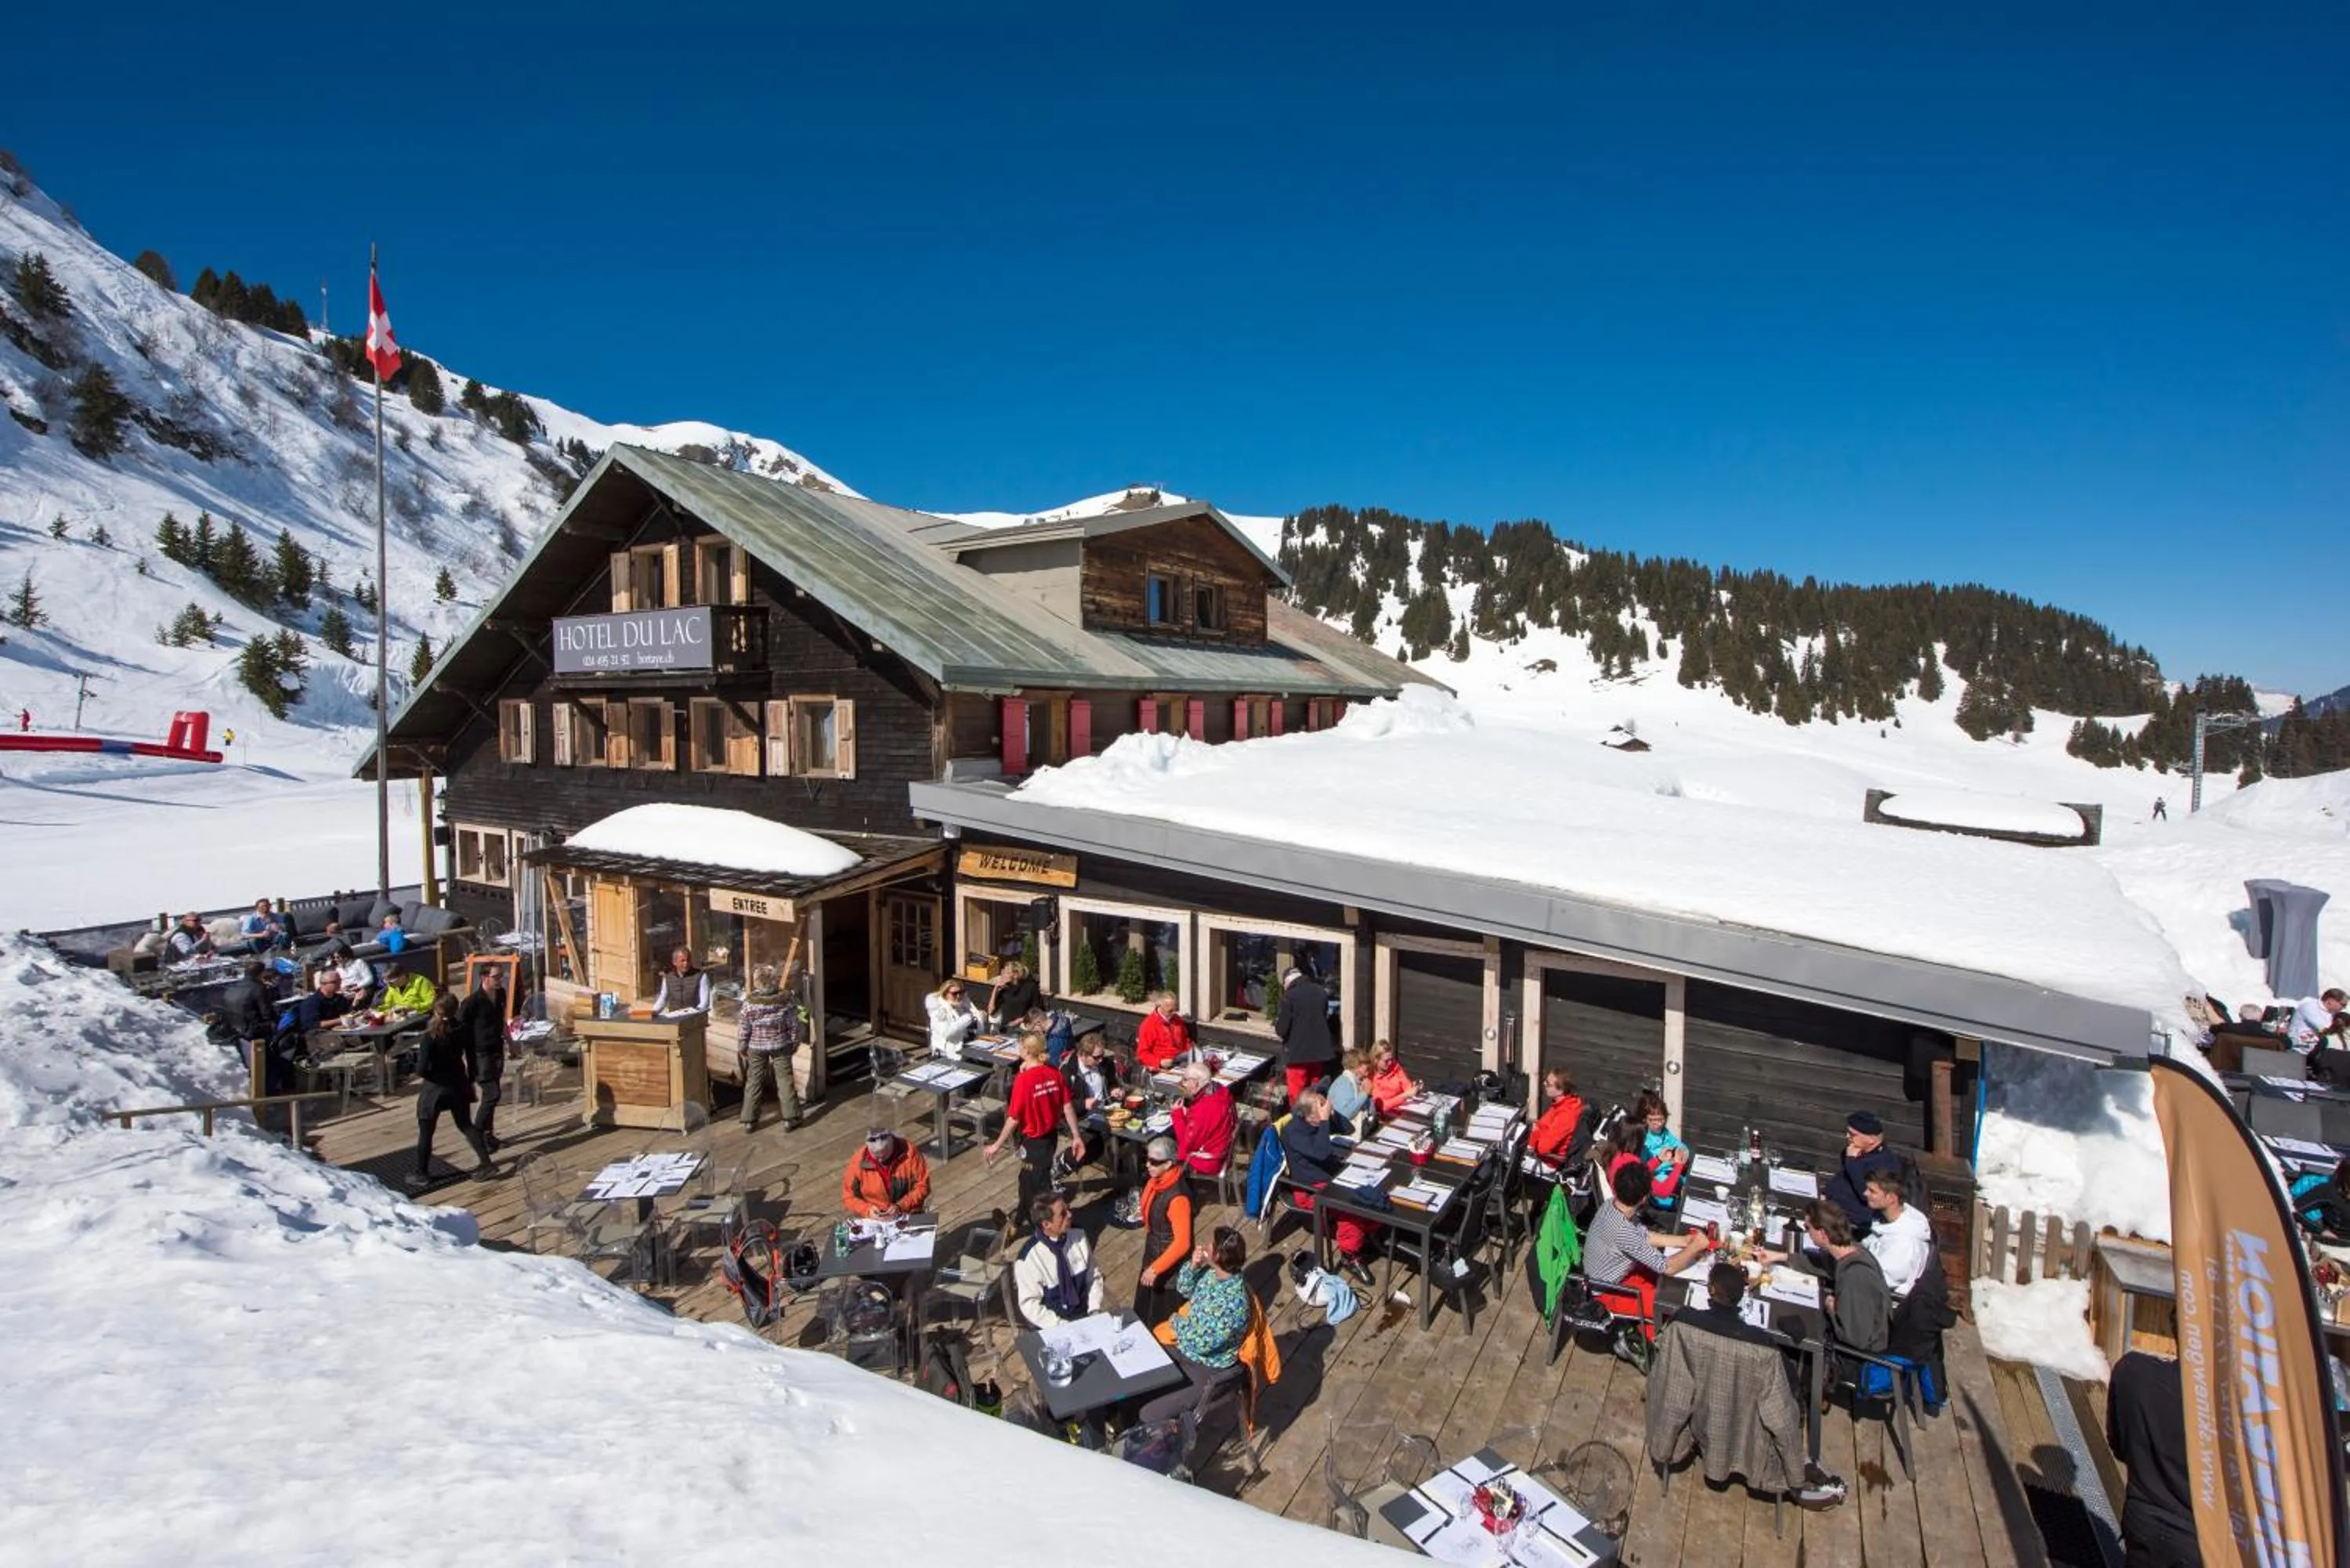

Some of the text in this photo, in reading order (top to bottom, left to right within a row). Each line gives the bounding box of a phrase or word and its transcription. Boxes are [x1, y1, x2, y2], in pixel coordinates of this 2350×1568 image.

[559, 616, 703, 650] HOTEL DU LAC
[978, 854, 1050, 874] WELCOME
[732, 897, 768, 915] ENTREE
